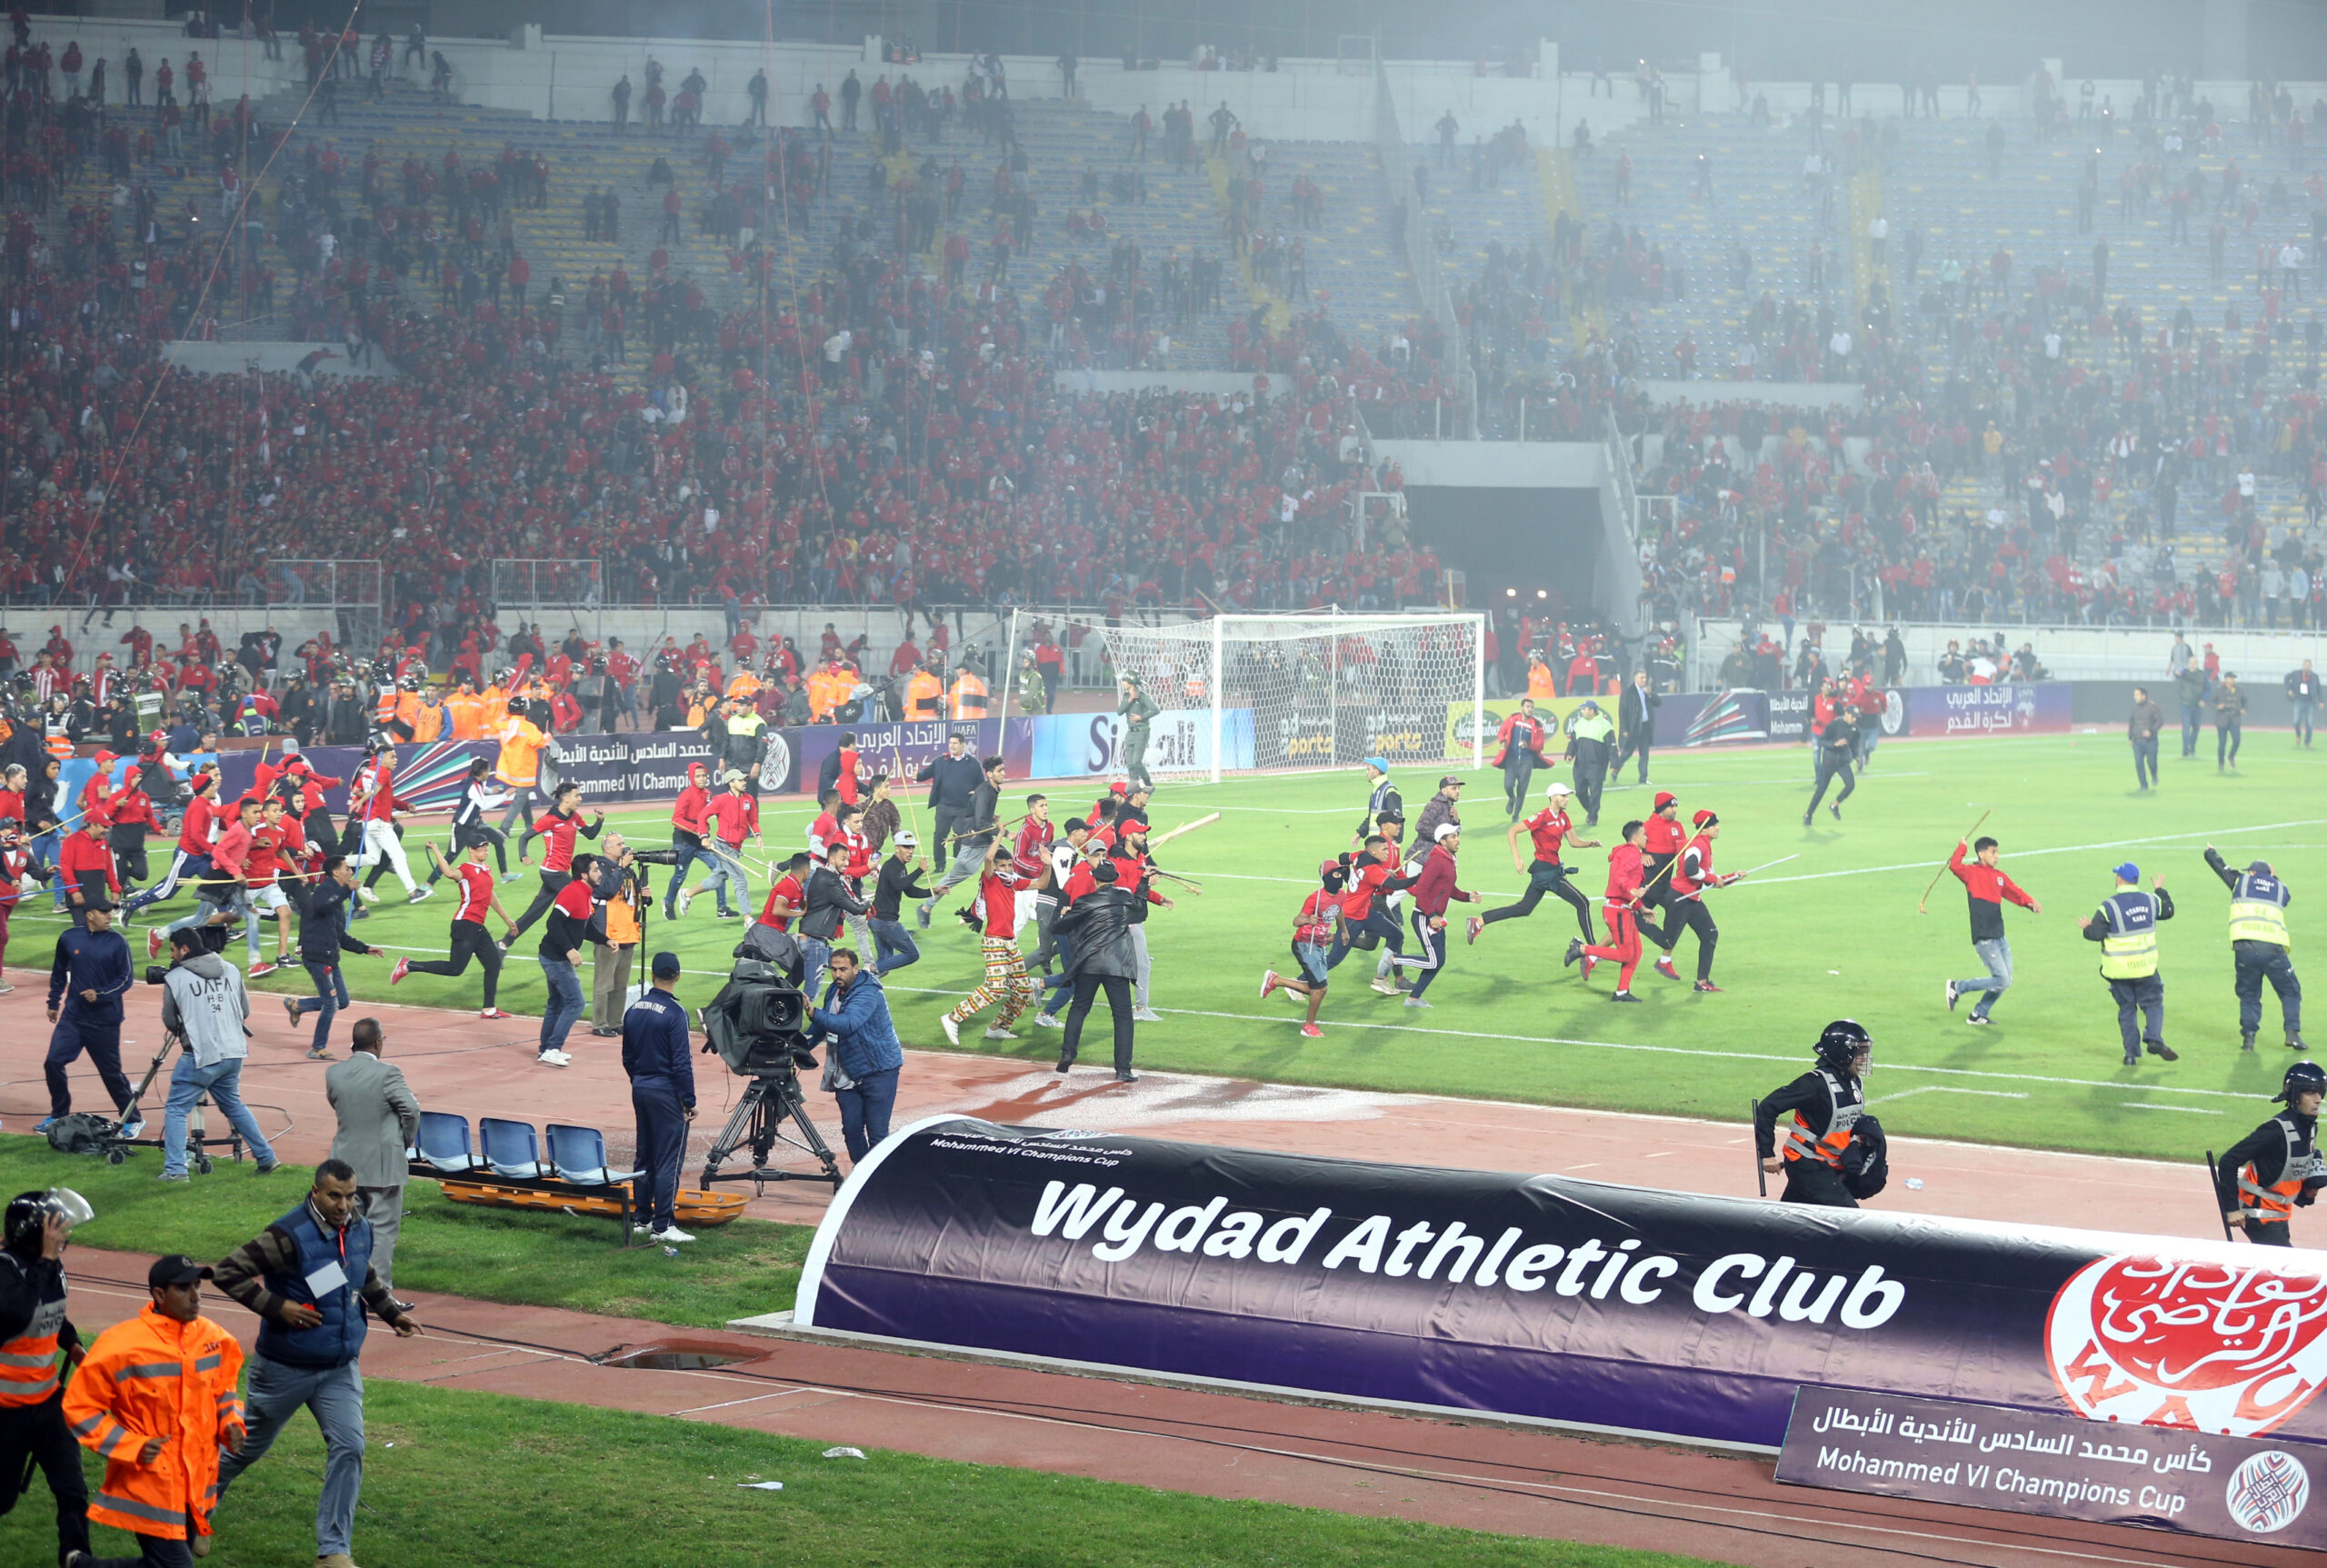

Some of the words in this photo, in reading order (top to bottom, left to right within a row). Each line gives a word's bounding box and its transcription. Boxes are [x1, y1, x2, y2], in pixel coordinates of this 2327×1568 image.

[189, 977, 233, 997] UAFA
[930, 1138, 1007, 1154] Mohammed
[1006, 1146, 1022, 1155] VI
[1021, 1148, 1093, 1164] Champions
[1094, 1156, 1120, 1168] Cup
[1031, 1180, 1331, 1265] Wydad
[1323, 1214, 1678, 1305] Athletic
[1693, 1253, 1905, 1330] Club
[1813, 1406, 1894, 1436] الأبطال
[1898, 1416, 1976, 1443] للأندية
[1979, 1430, 2074, 1455] السادس
[2078, 1441, 2148, 1464] محمد
[2152, 1443, 2212, 1473] كأس
[1817, 1445, 1960, 1484] Mohammed
[1966, 1463, 1990, 1488] VI
[1995, 1467, 2131, 1505] Champions
[2139, 1485, 2185, 1517] Cup
